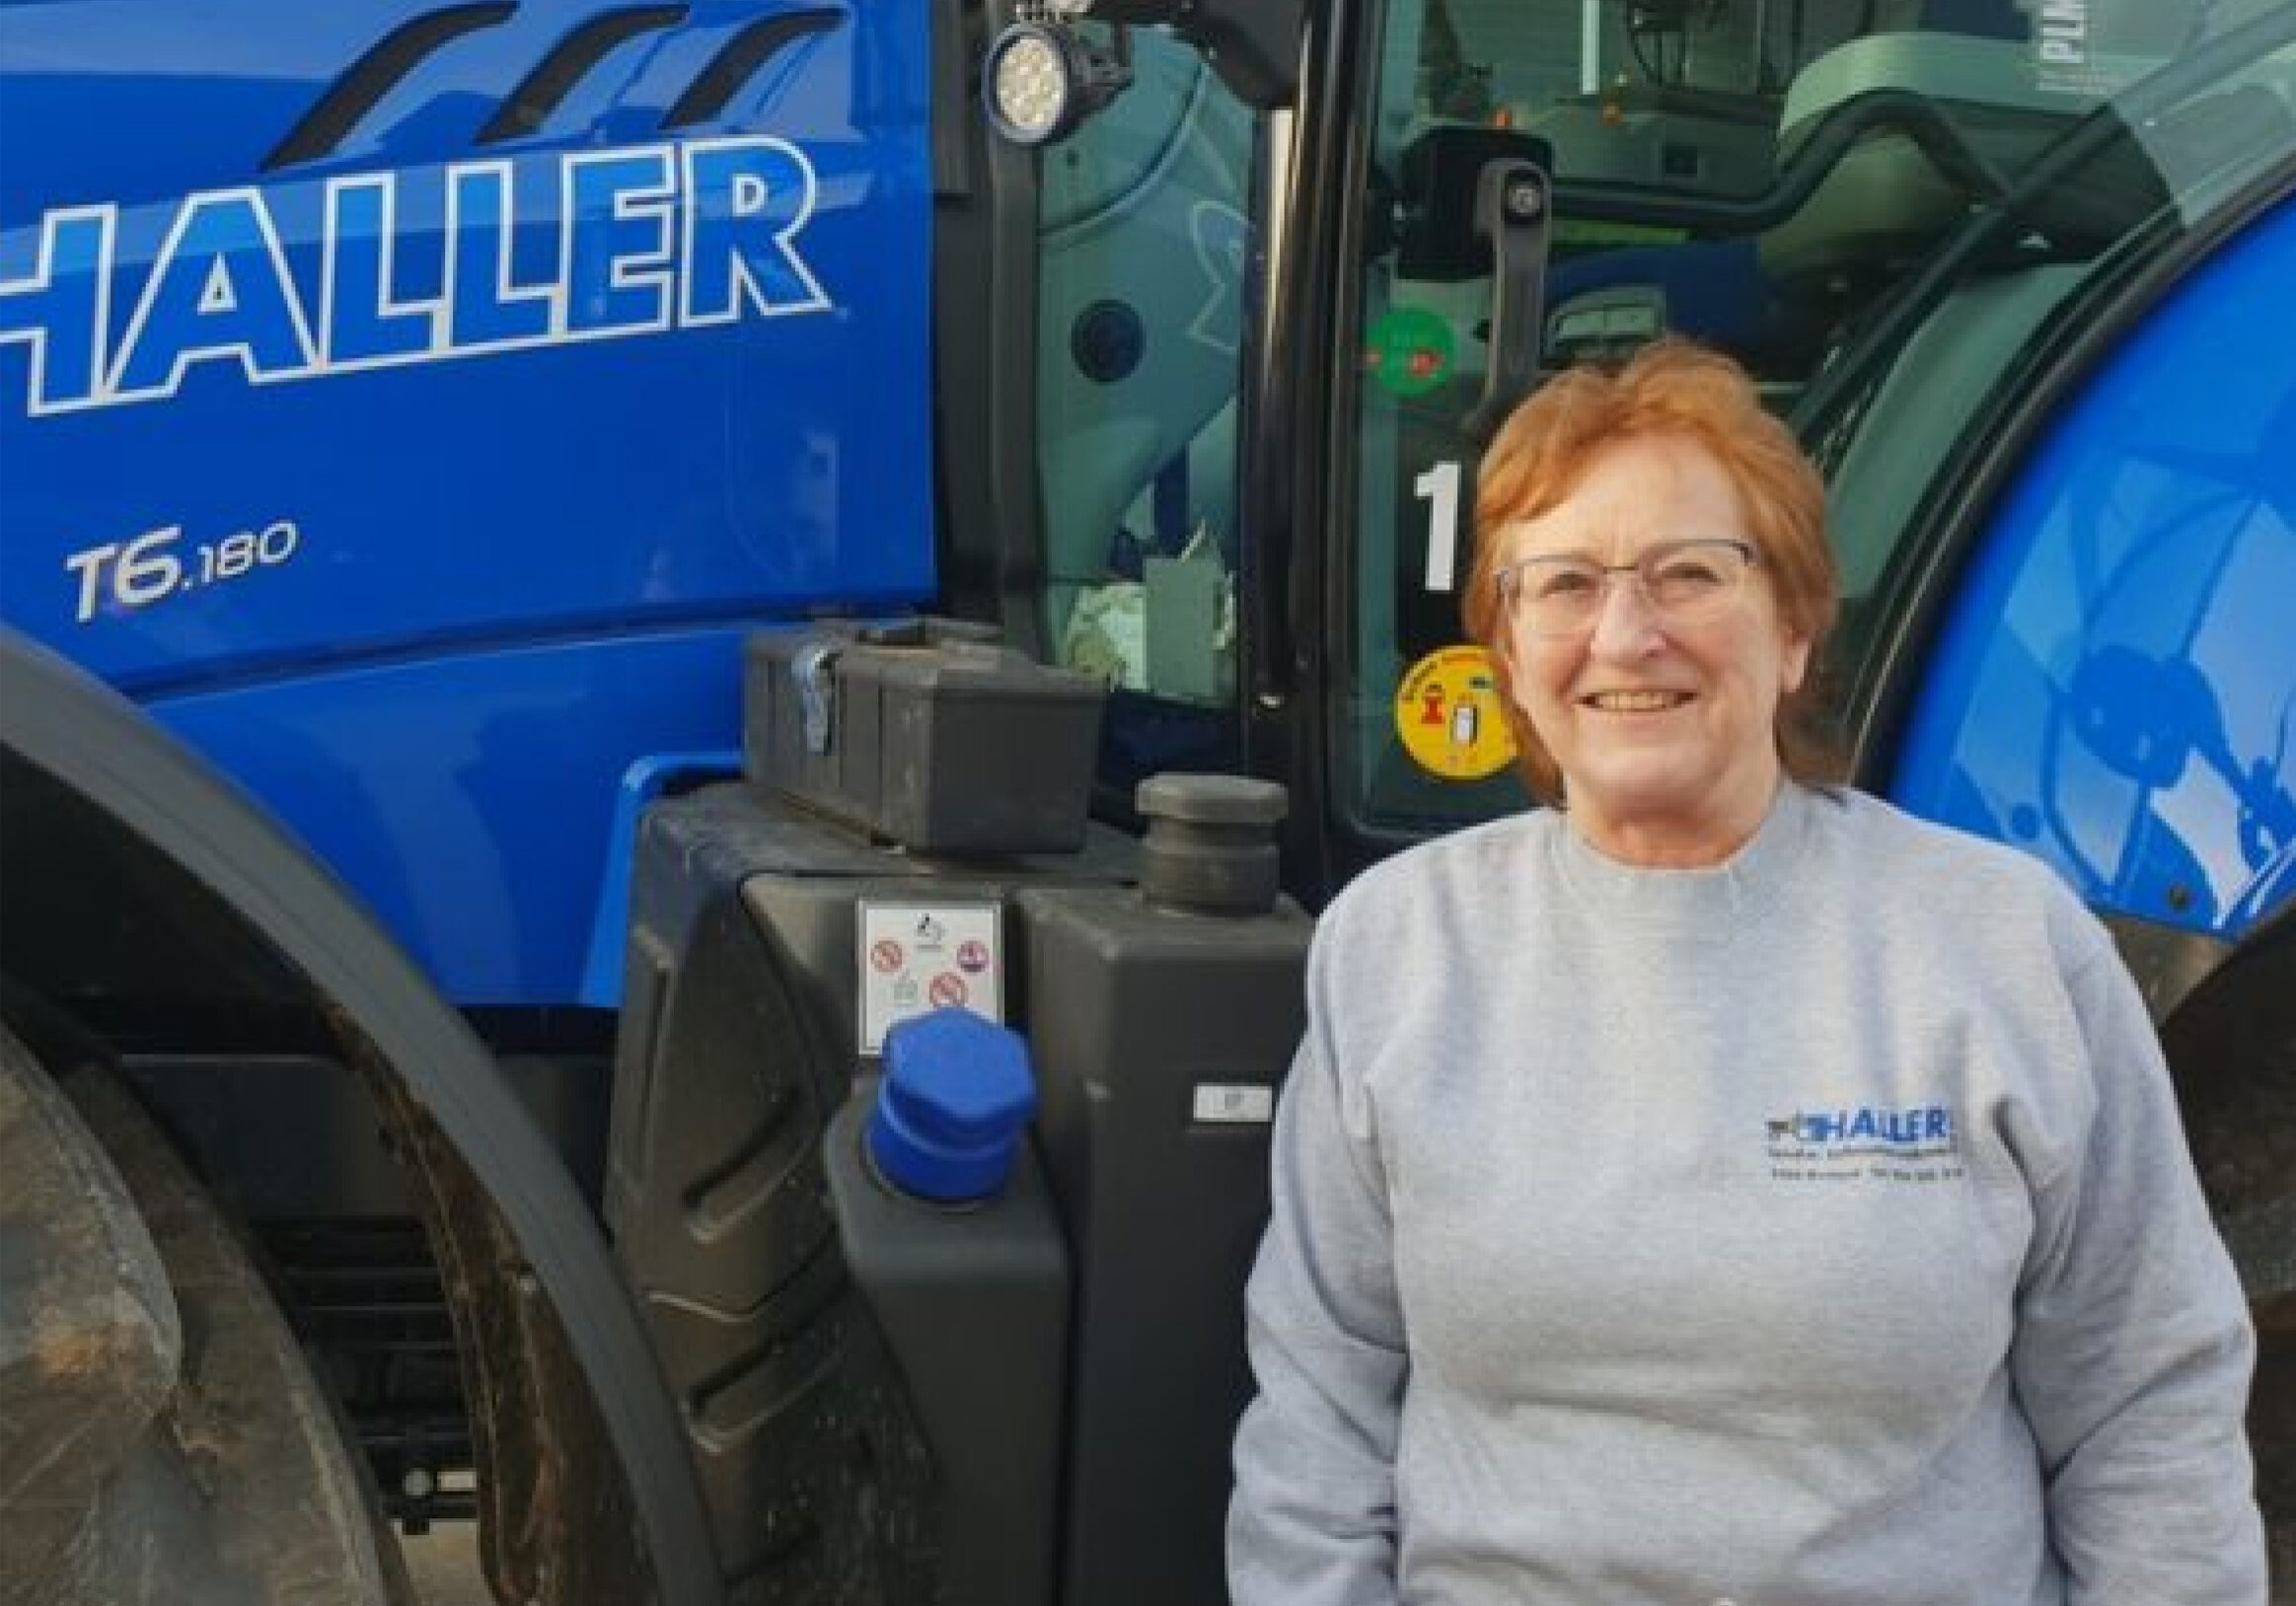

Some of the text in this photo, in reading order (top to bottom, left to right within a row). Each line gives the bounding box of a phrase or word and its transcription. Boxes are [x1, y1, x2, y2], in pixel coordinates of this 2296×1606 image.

[0, 135, 832, 417] HALLER
[65, 521, 299, 623] T6.180
[1812, 1105, 1950, 1142] HALLER
